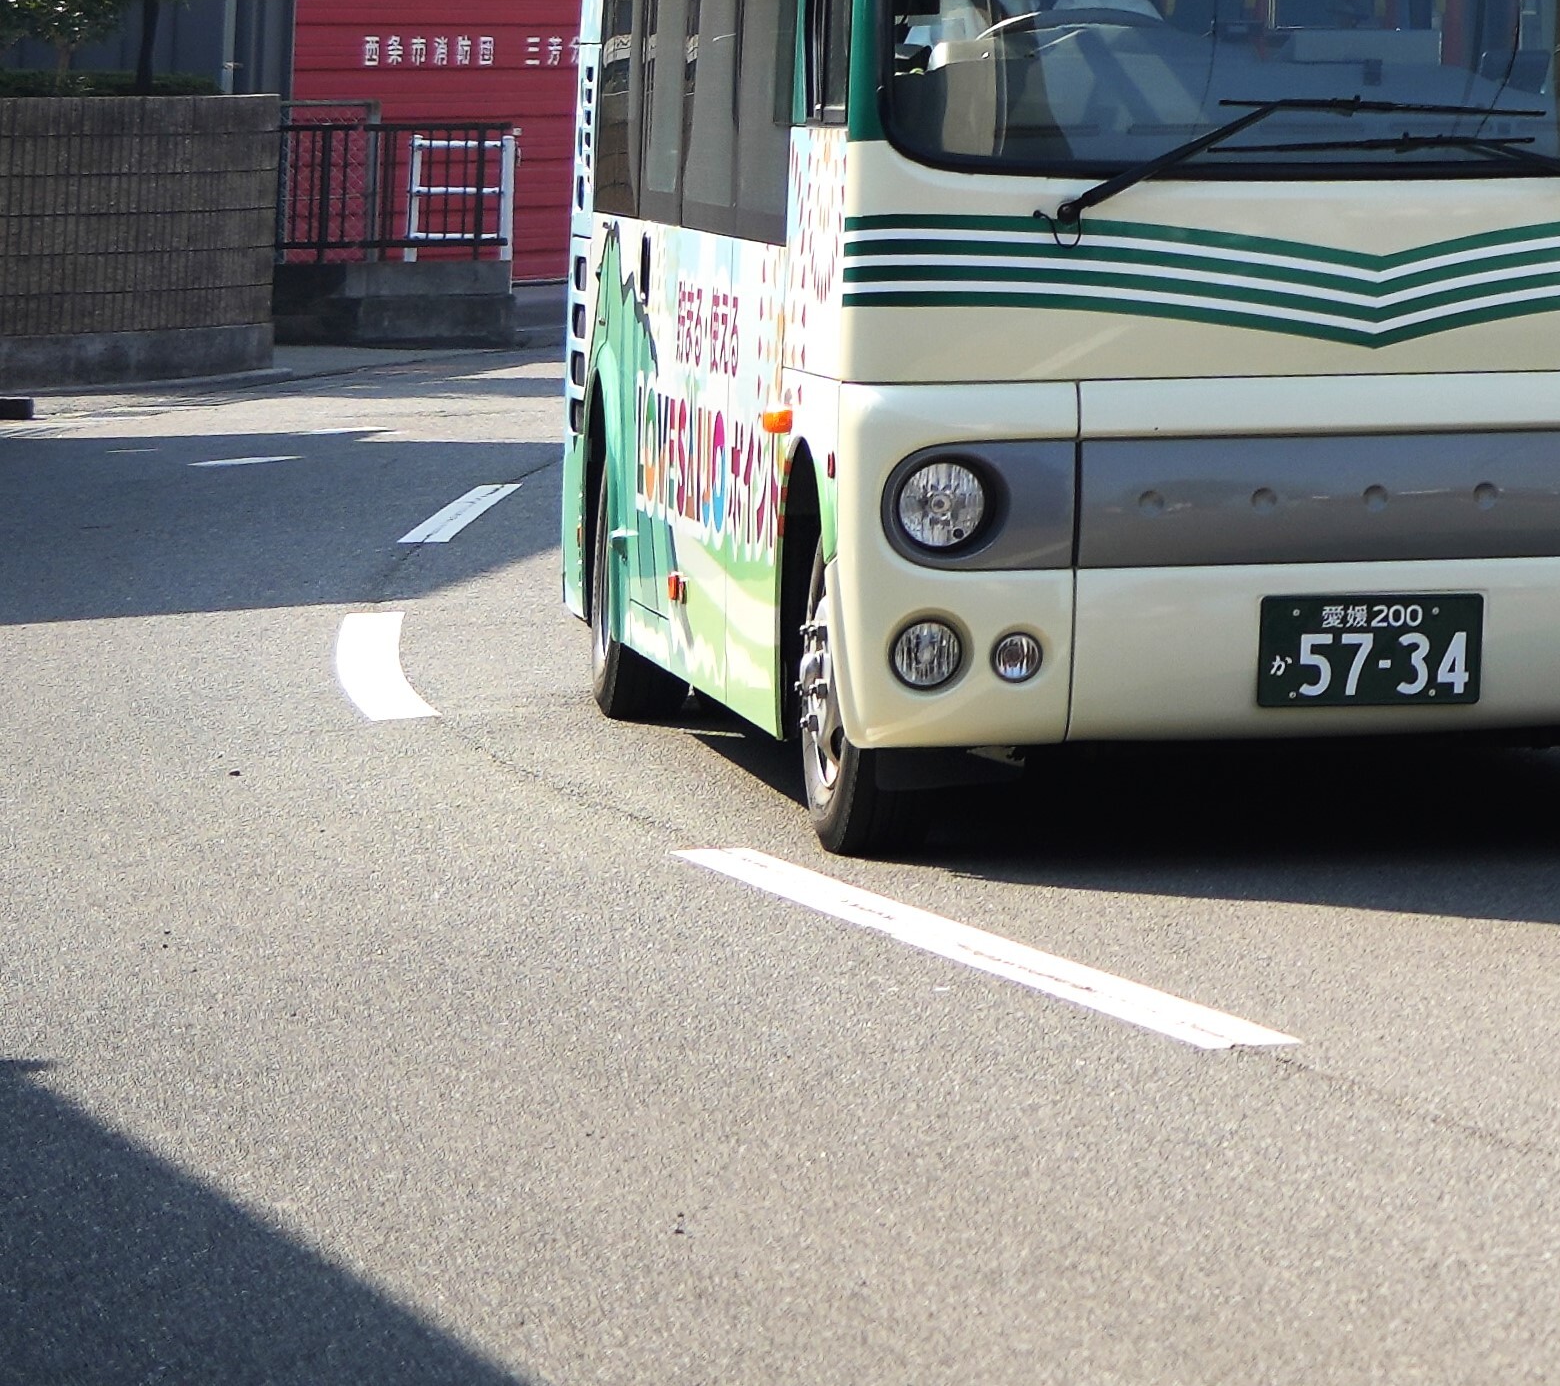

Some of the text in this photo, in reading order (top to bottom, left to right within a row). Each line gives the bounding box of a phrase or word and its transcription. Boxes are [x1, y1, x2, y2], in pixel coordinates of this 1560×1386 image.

[364, 36, 494, 66] 西条市消防団
[1269, 631, 1470, 697] か 57-34
